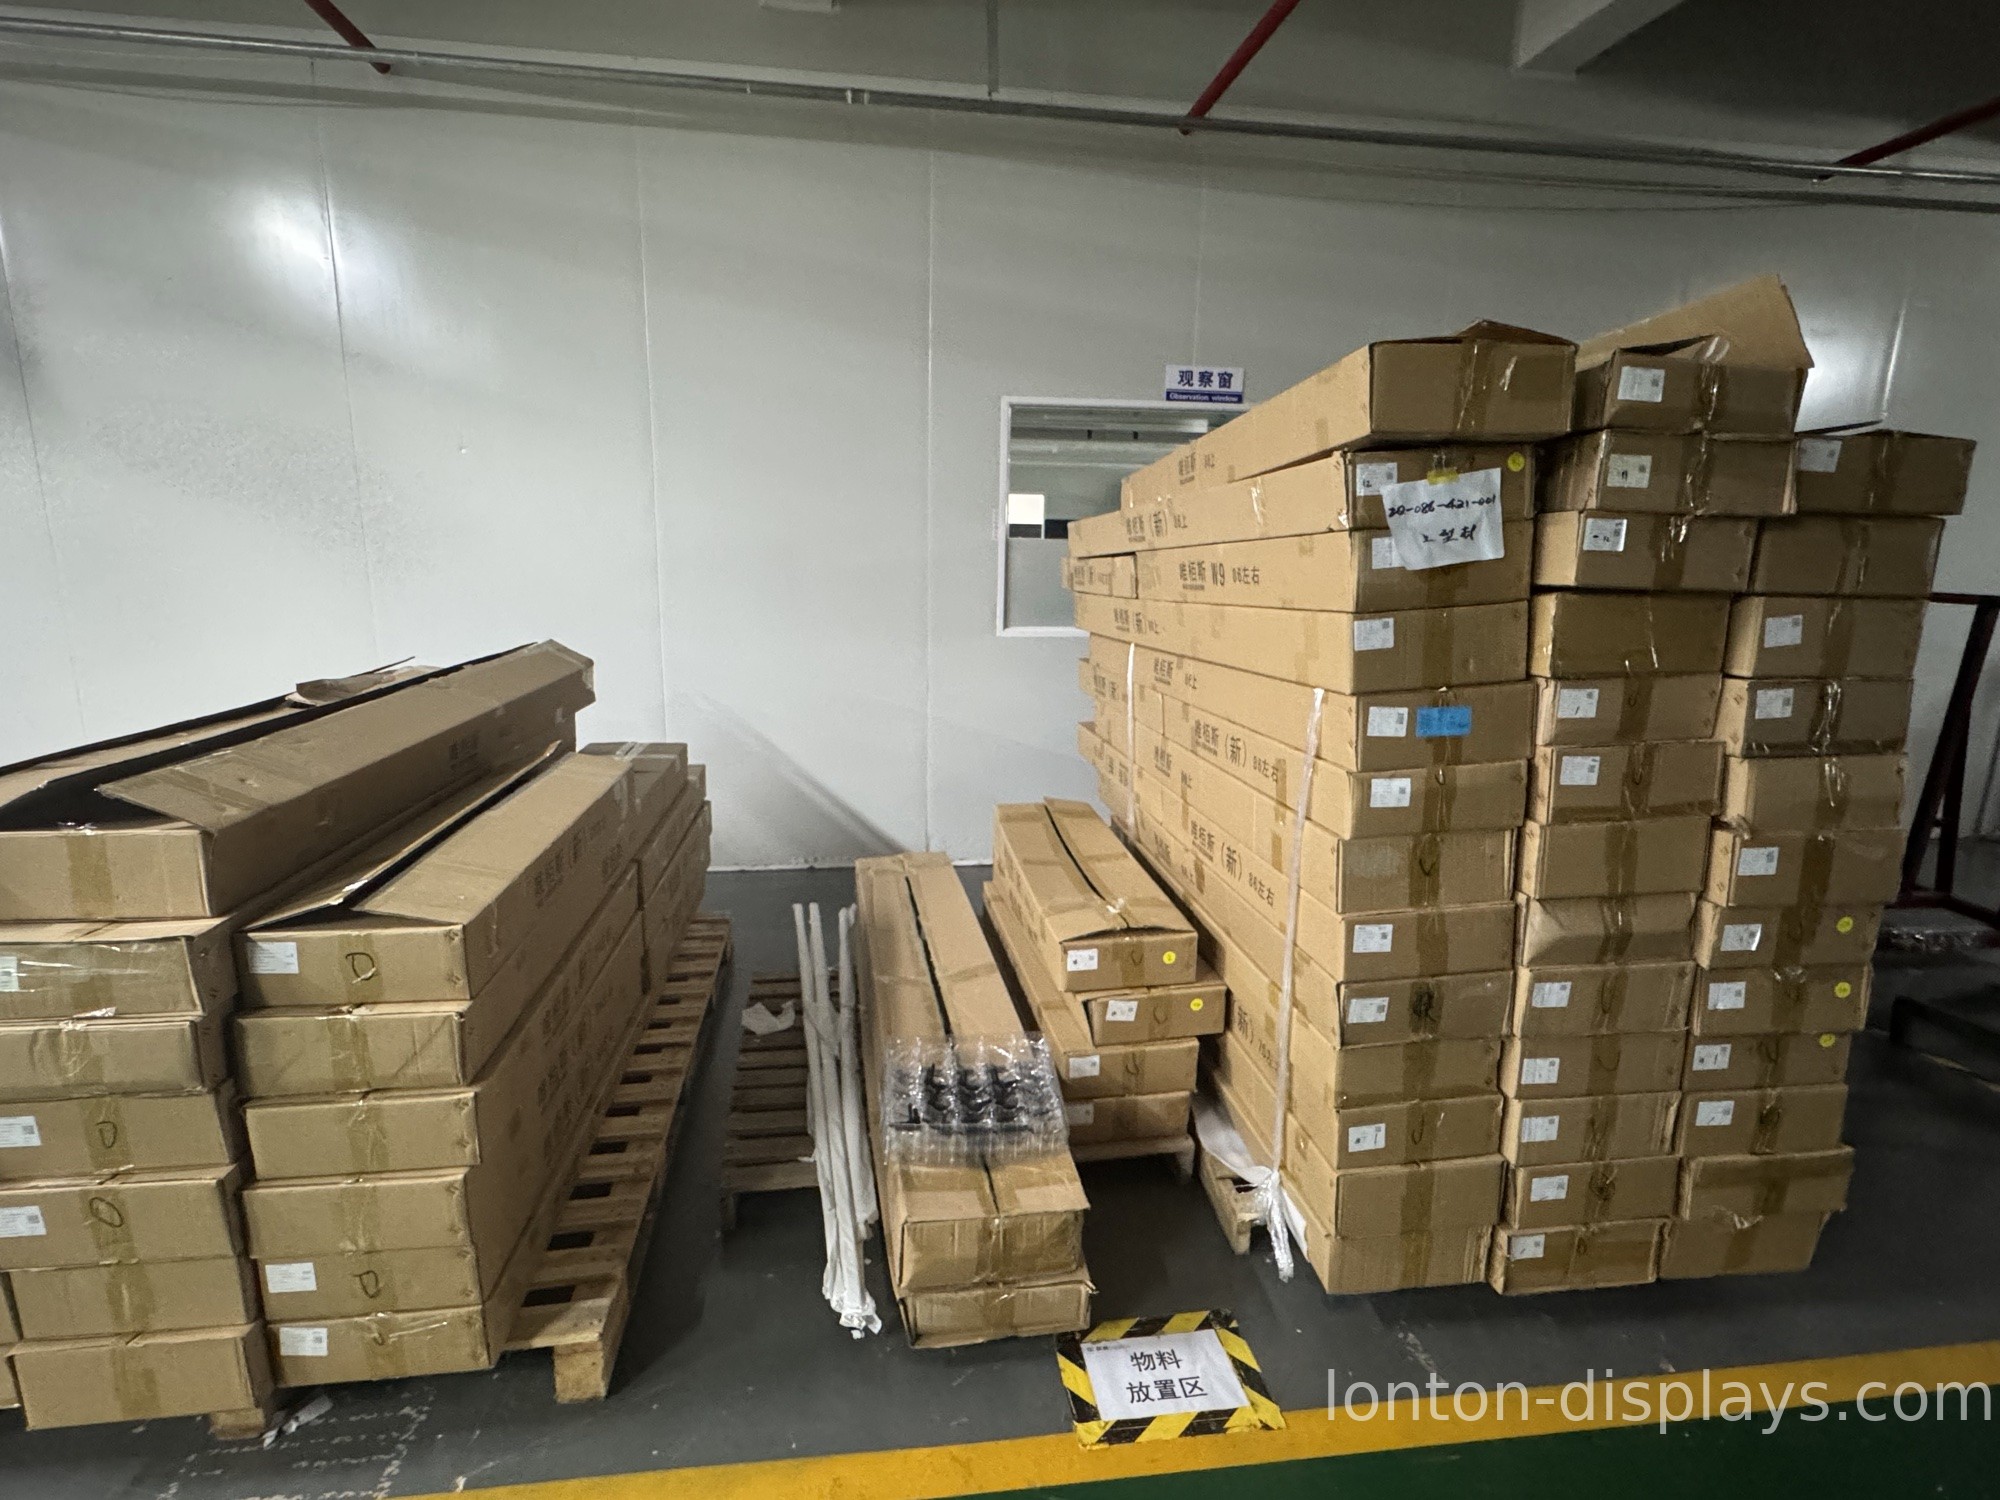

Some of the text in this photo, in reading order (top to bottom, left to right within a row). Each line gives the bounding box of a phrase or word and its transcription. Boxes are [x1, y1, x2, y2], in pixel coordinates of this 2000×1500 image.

[1178, 370, 1233, 389] 观察窗
[1169, 392, 1239, 402] Observation window
[1211, 562, 1225, 586] W9
[1130, 1349, 1182, 1372] 物料
[1126, 1376, 1207, 1404] 放置区
